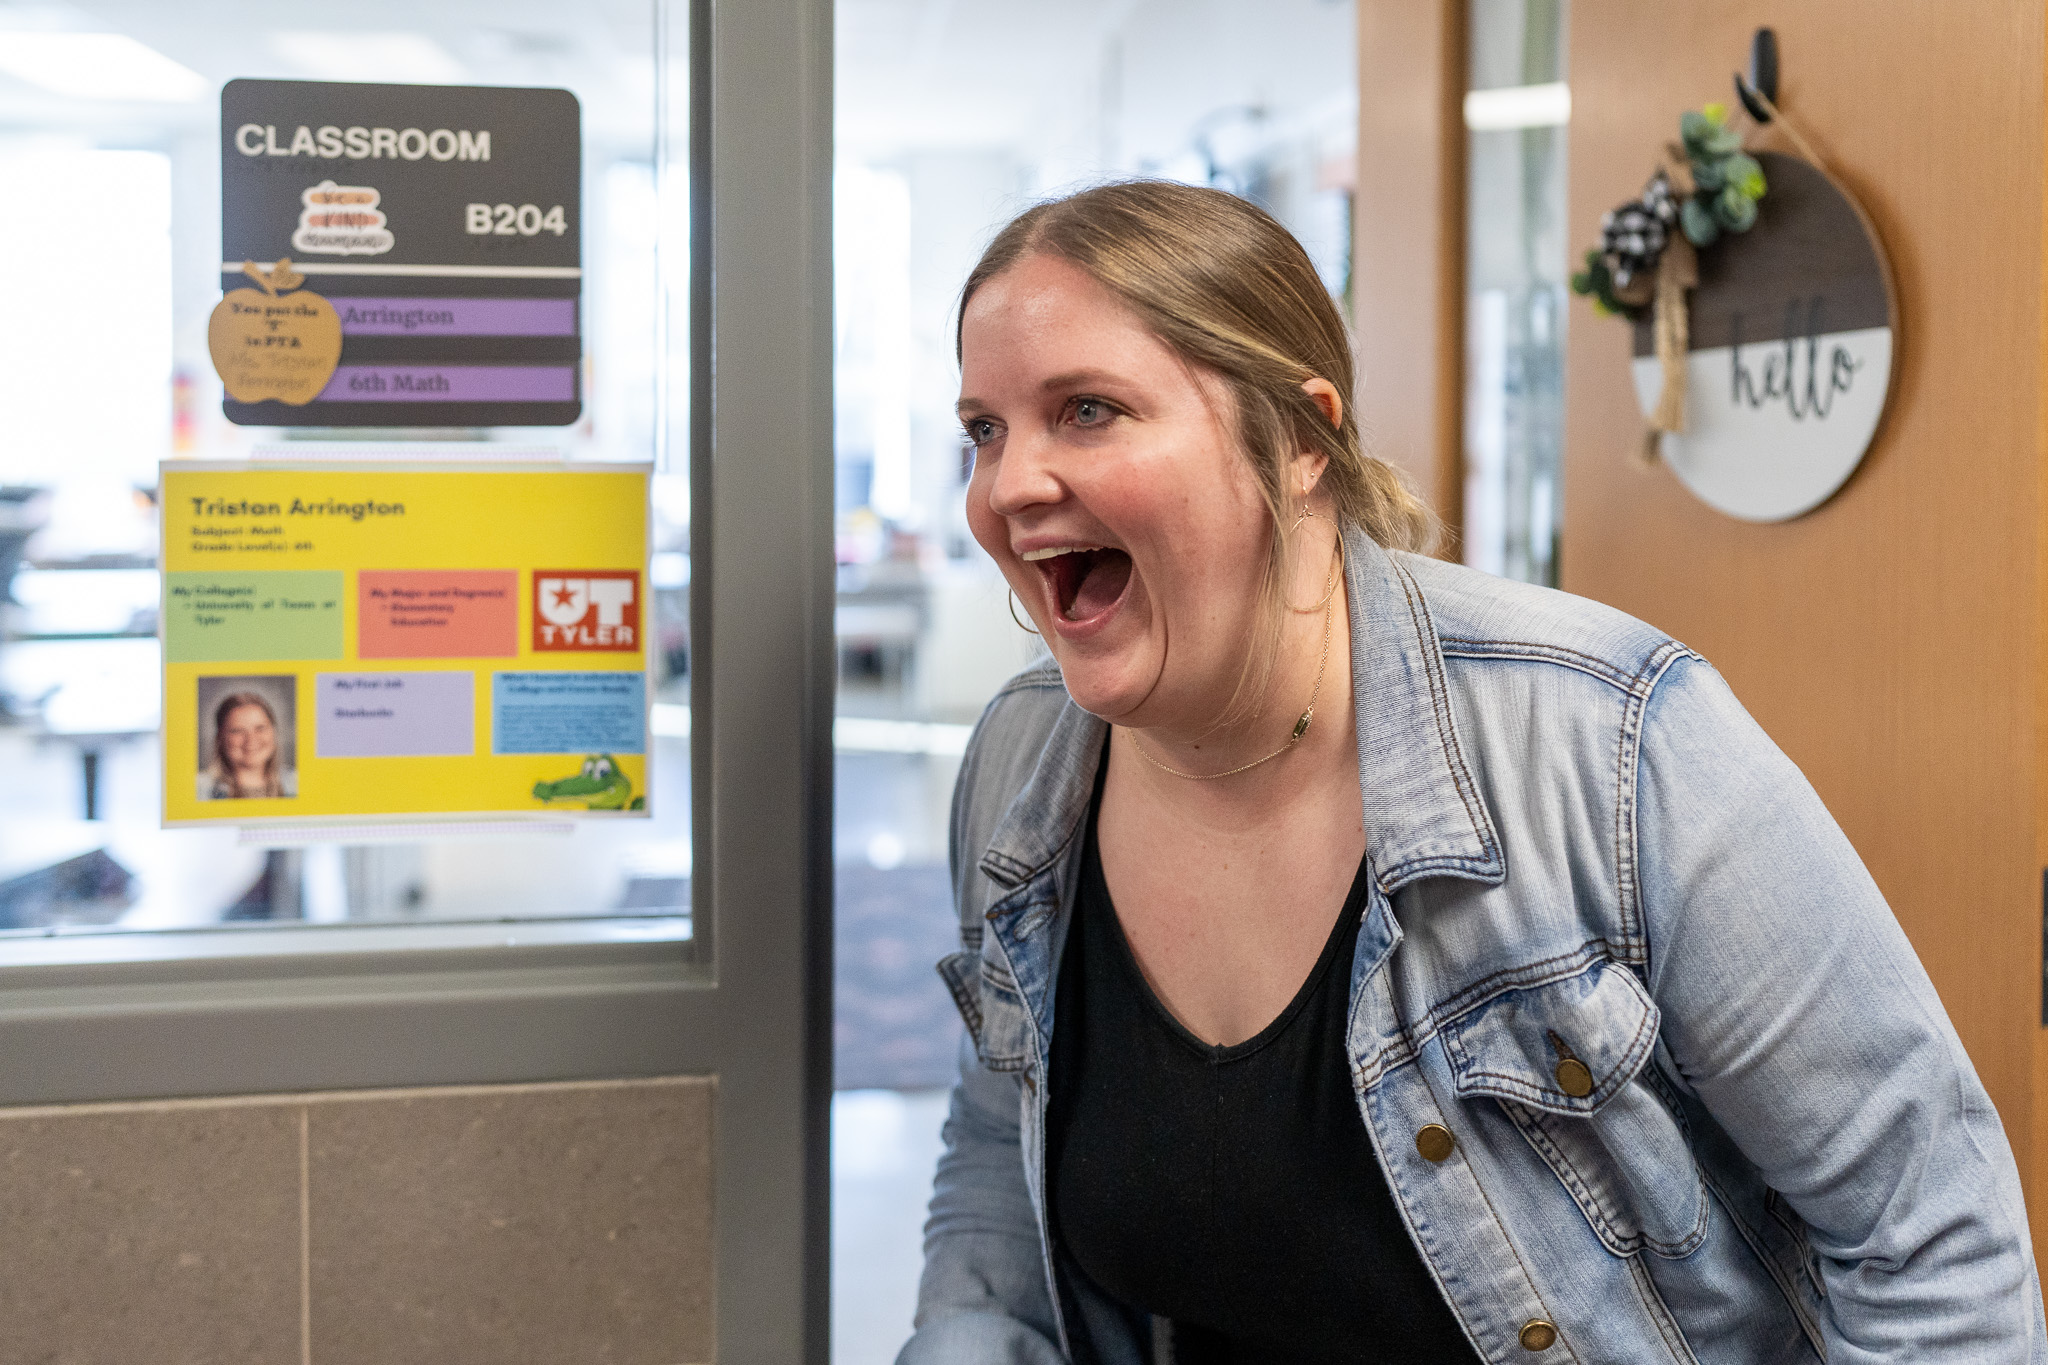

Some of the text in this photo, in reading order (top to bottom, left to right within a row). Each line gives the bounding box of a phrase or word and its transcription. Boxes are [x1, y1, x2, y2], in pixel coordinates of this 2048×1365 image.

[235, 124, 492, 162] CLASSROOM
[465, 203, 567, 236] B204
[345, 304, 455, 330] Arrington
[1730, 296, 1863, 421] hello
[349, 373, 451, 393] 6th Math
[191, 498, 406, 522] Tristan Arrington
[538, 578, 635, 625] UT
[541, 625, 635, 646] TYLER
